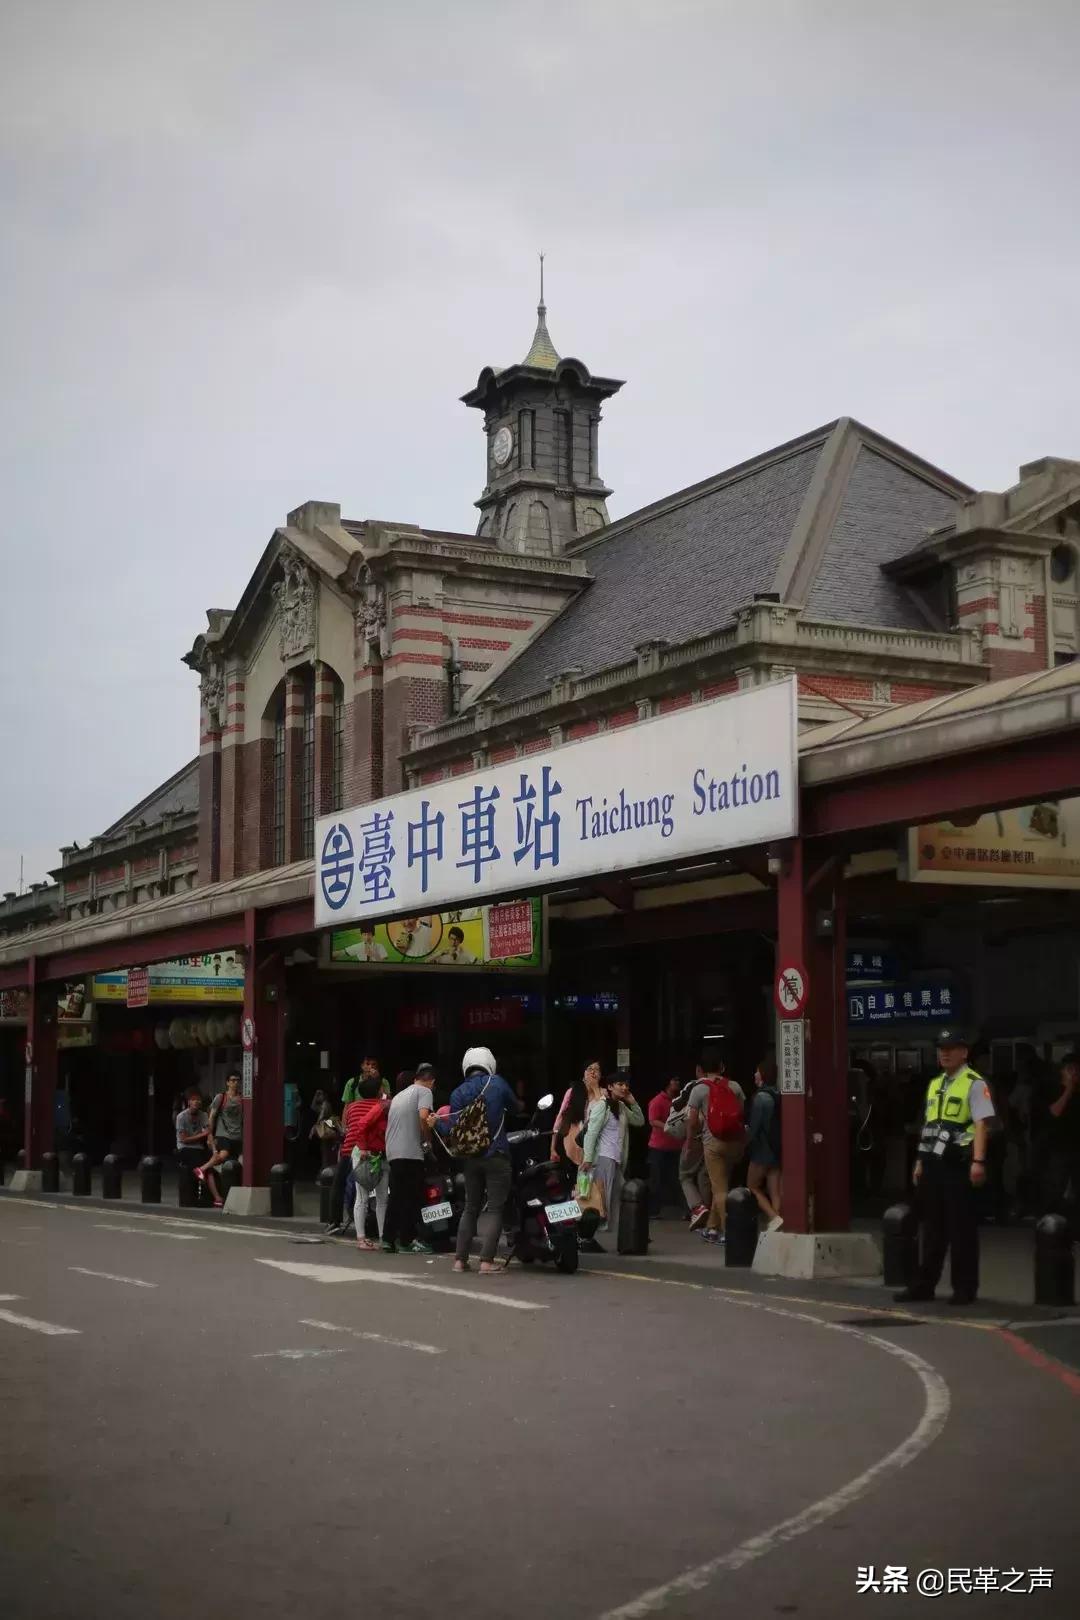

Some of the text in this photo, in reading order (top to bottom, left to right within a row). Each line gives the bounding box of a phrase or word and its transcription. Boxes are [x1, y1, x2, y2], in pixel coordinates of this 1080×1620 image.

[358, 766, 563, 904] 臺中車站
[575, 764, 781, 840] Taichung Station
[867, 988, 952, 1010] 自動售票機
